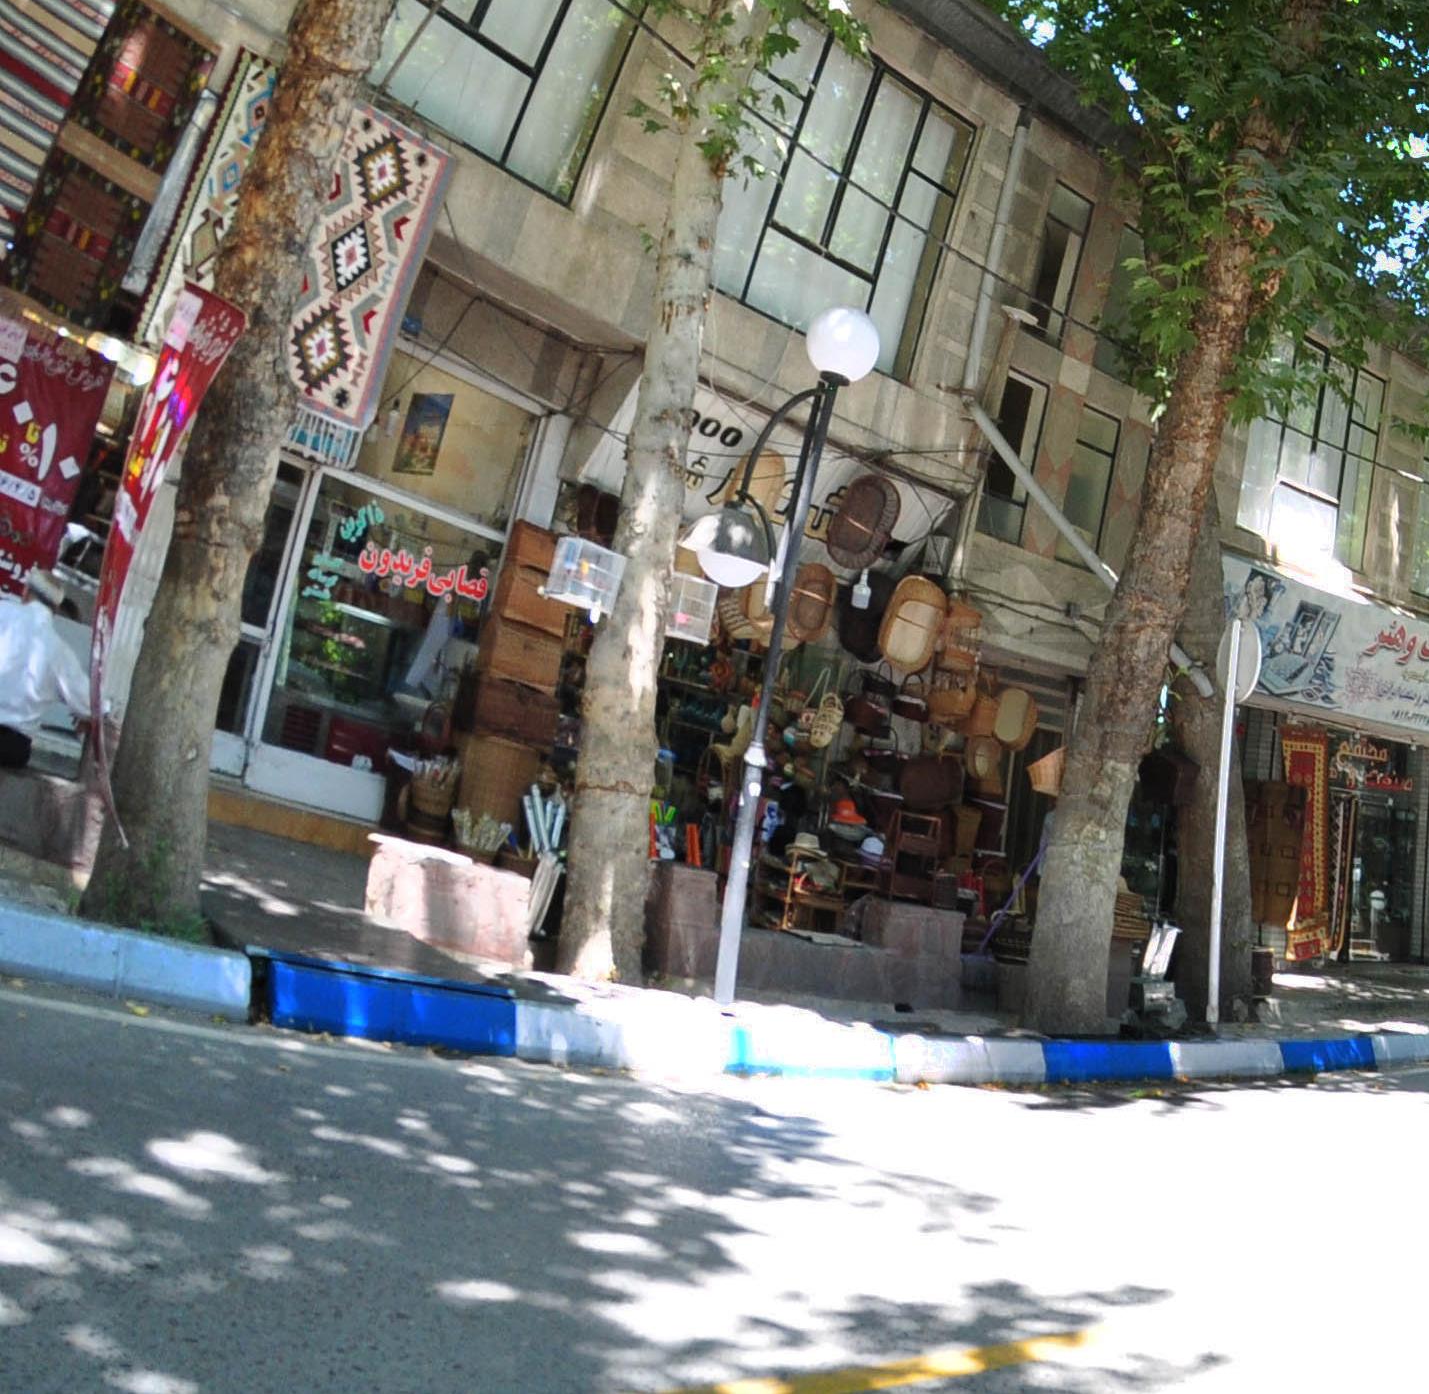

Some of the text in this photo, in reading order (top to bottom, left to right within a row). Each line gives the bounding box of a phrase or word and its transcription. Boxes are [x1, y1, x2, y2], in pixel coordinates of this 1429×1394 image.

[358, 540, 433, 588] فریدون
[427, 567, 490, 603] قصابی
[1362, 619, 1407, 657] هنر
